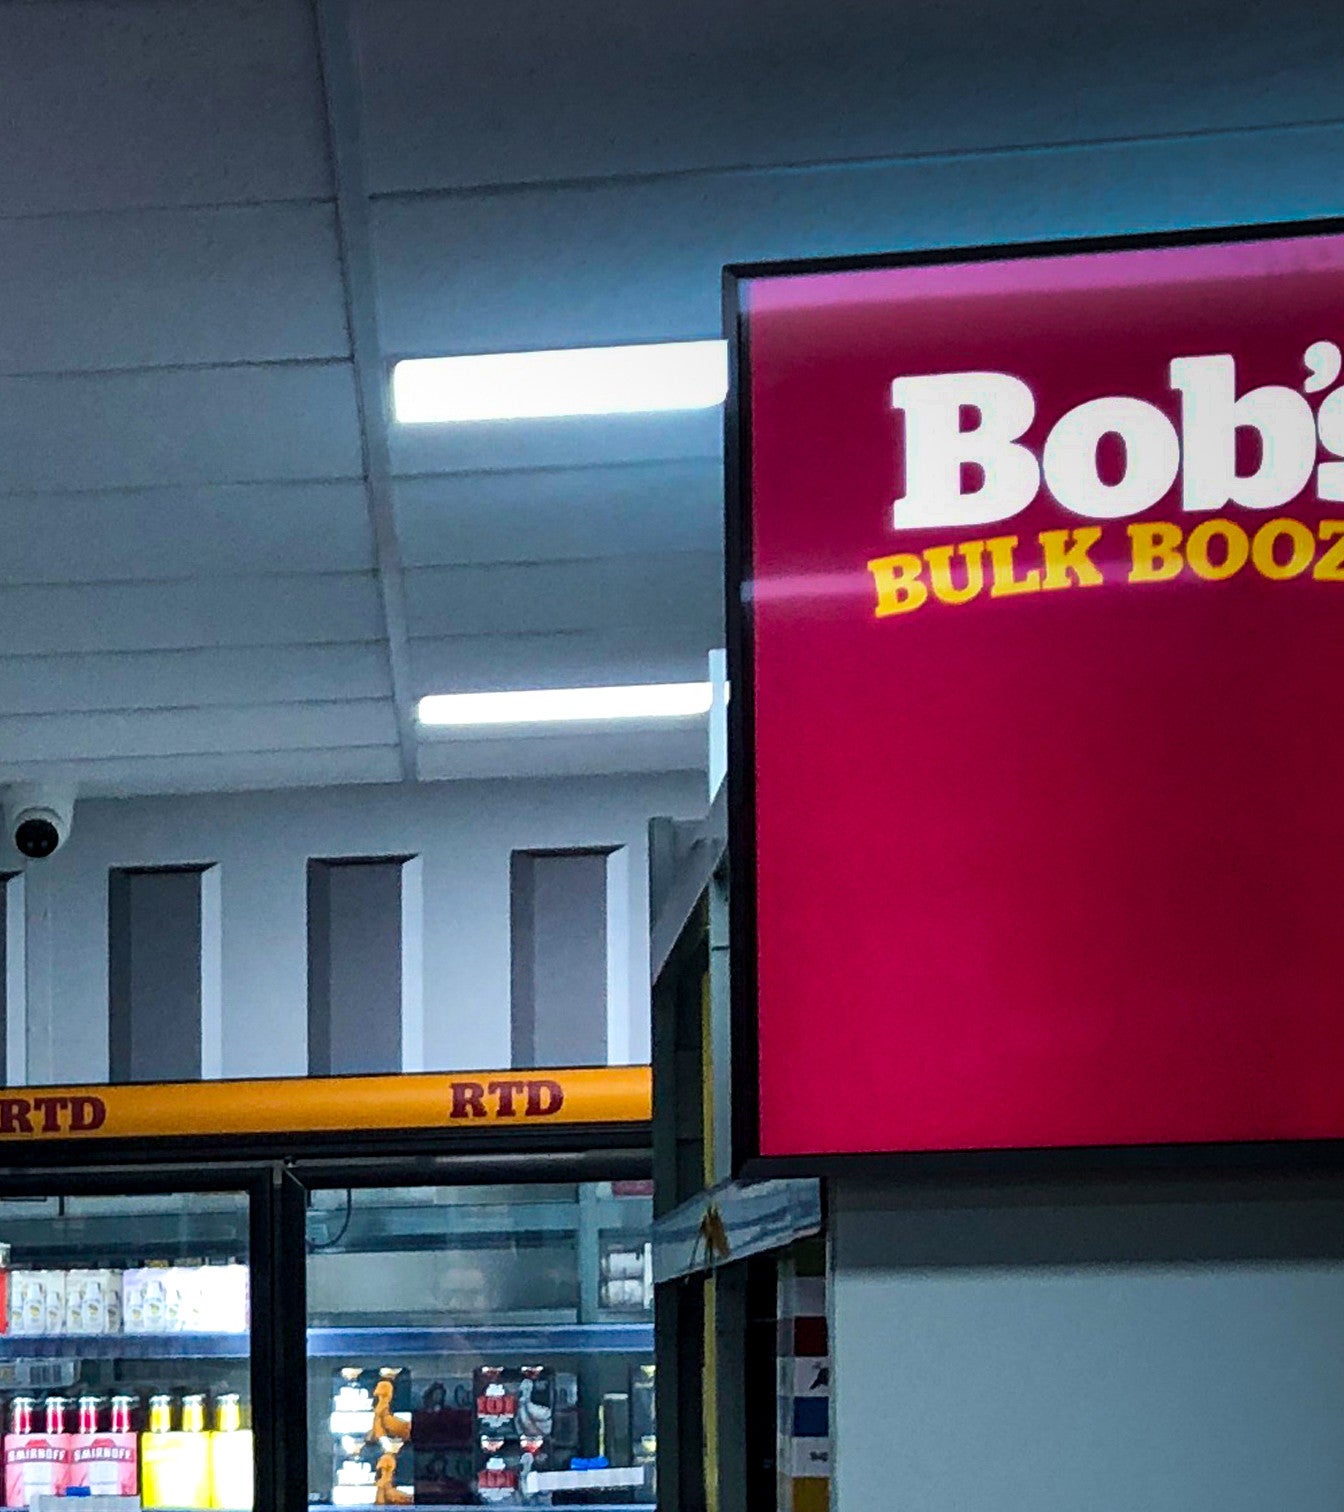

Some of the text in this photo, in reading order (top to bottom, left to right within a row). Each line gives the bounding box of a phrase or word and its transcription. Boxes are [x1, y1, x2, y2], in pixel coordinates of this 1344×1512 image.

[867, 526, 1103, 618] BULK
[449, 1081, 565, 1118] RTD
[8, 1448, 65, 1461] SMIRNOFF
[74, 1448, 131, 1461] SMIRNOFF
